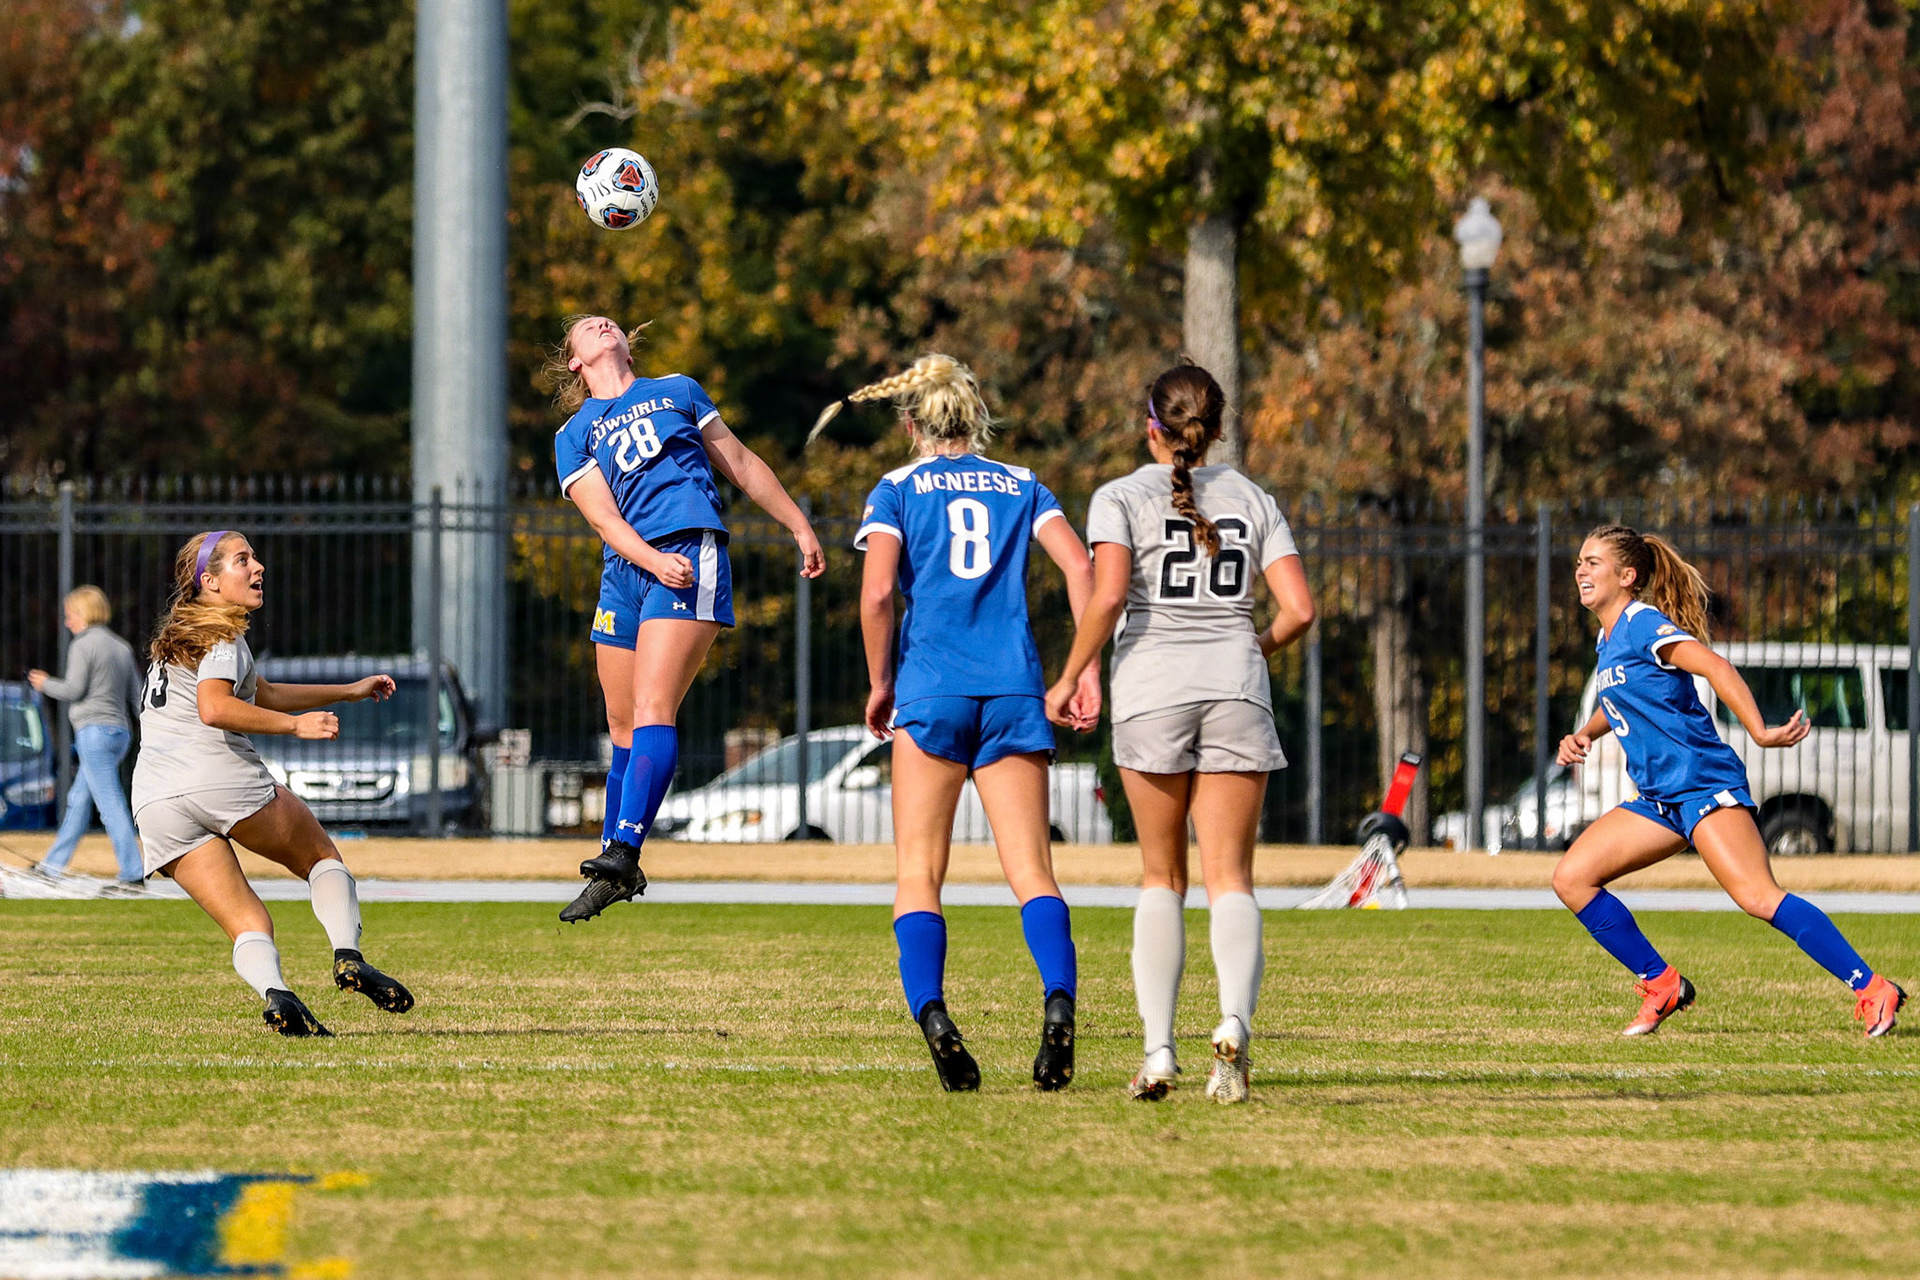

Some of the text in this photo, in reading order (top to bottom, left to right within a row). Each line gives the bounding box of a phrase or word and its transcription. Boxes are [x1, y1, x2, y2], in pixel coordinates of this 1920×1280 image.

[607, 417, 663, 473] 28
[947, 498, 993, 580] 8
[1155, 514, 1252, 603] 26
[592, 607, 617, 636] M
[1601, 696, 1630, 737] 9
